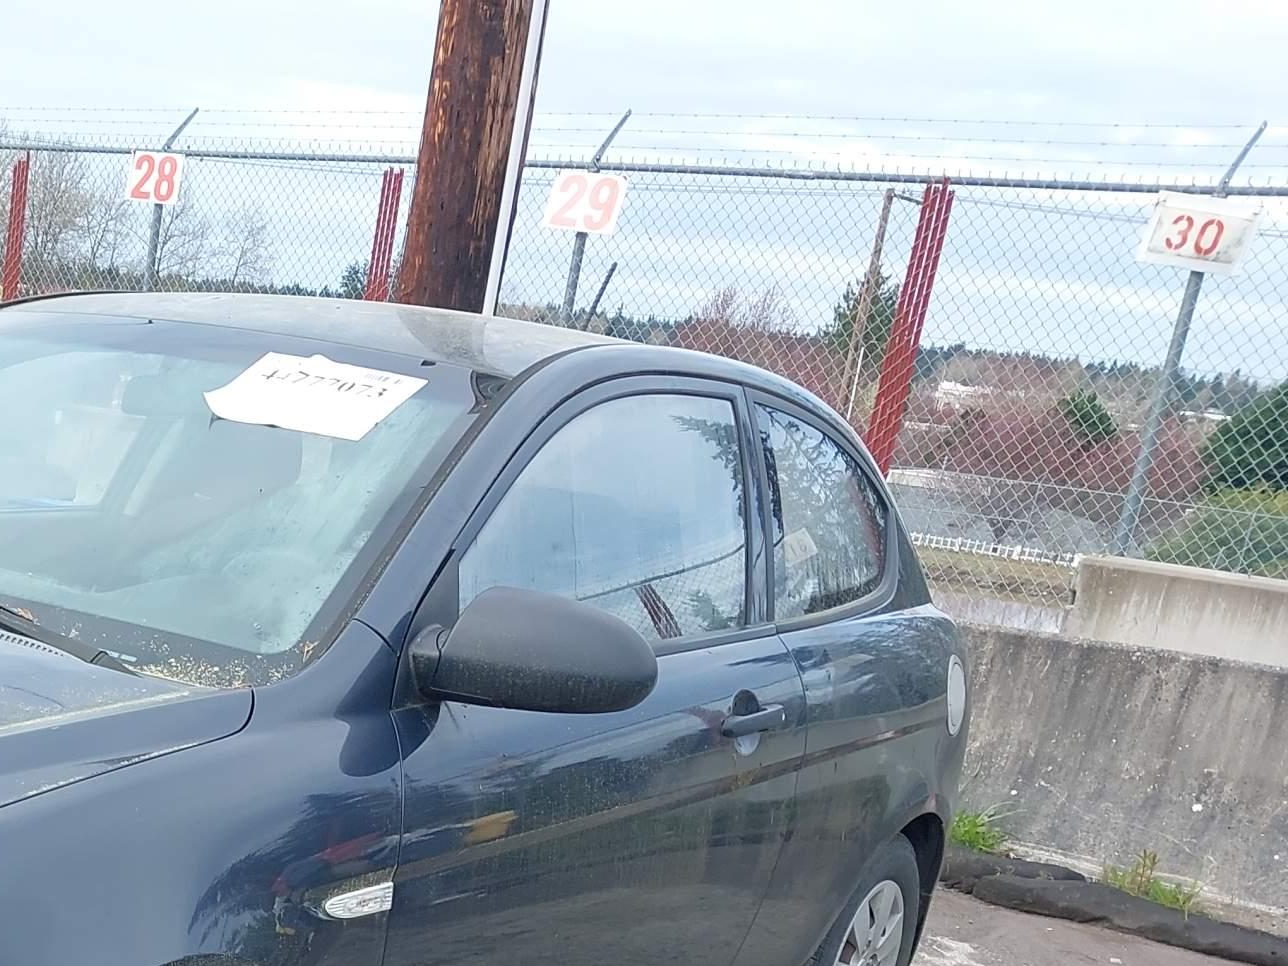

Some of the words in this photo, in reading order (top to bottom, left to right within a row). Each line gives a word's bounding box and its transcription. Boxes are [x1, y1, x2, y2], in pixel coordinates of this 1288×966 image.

[130, 154, 177, 201] 28
[549, 175, 619, 230] 29
[1165, 215, 1224, 256] 30
